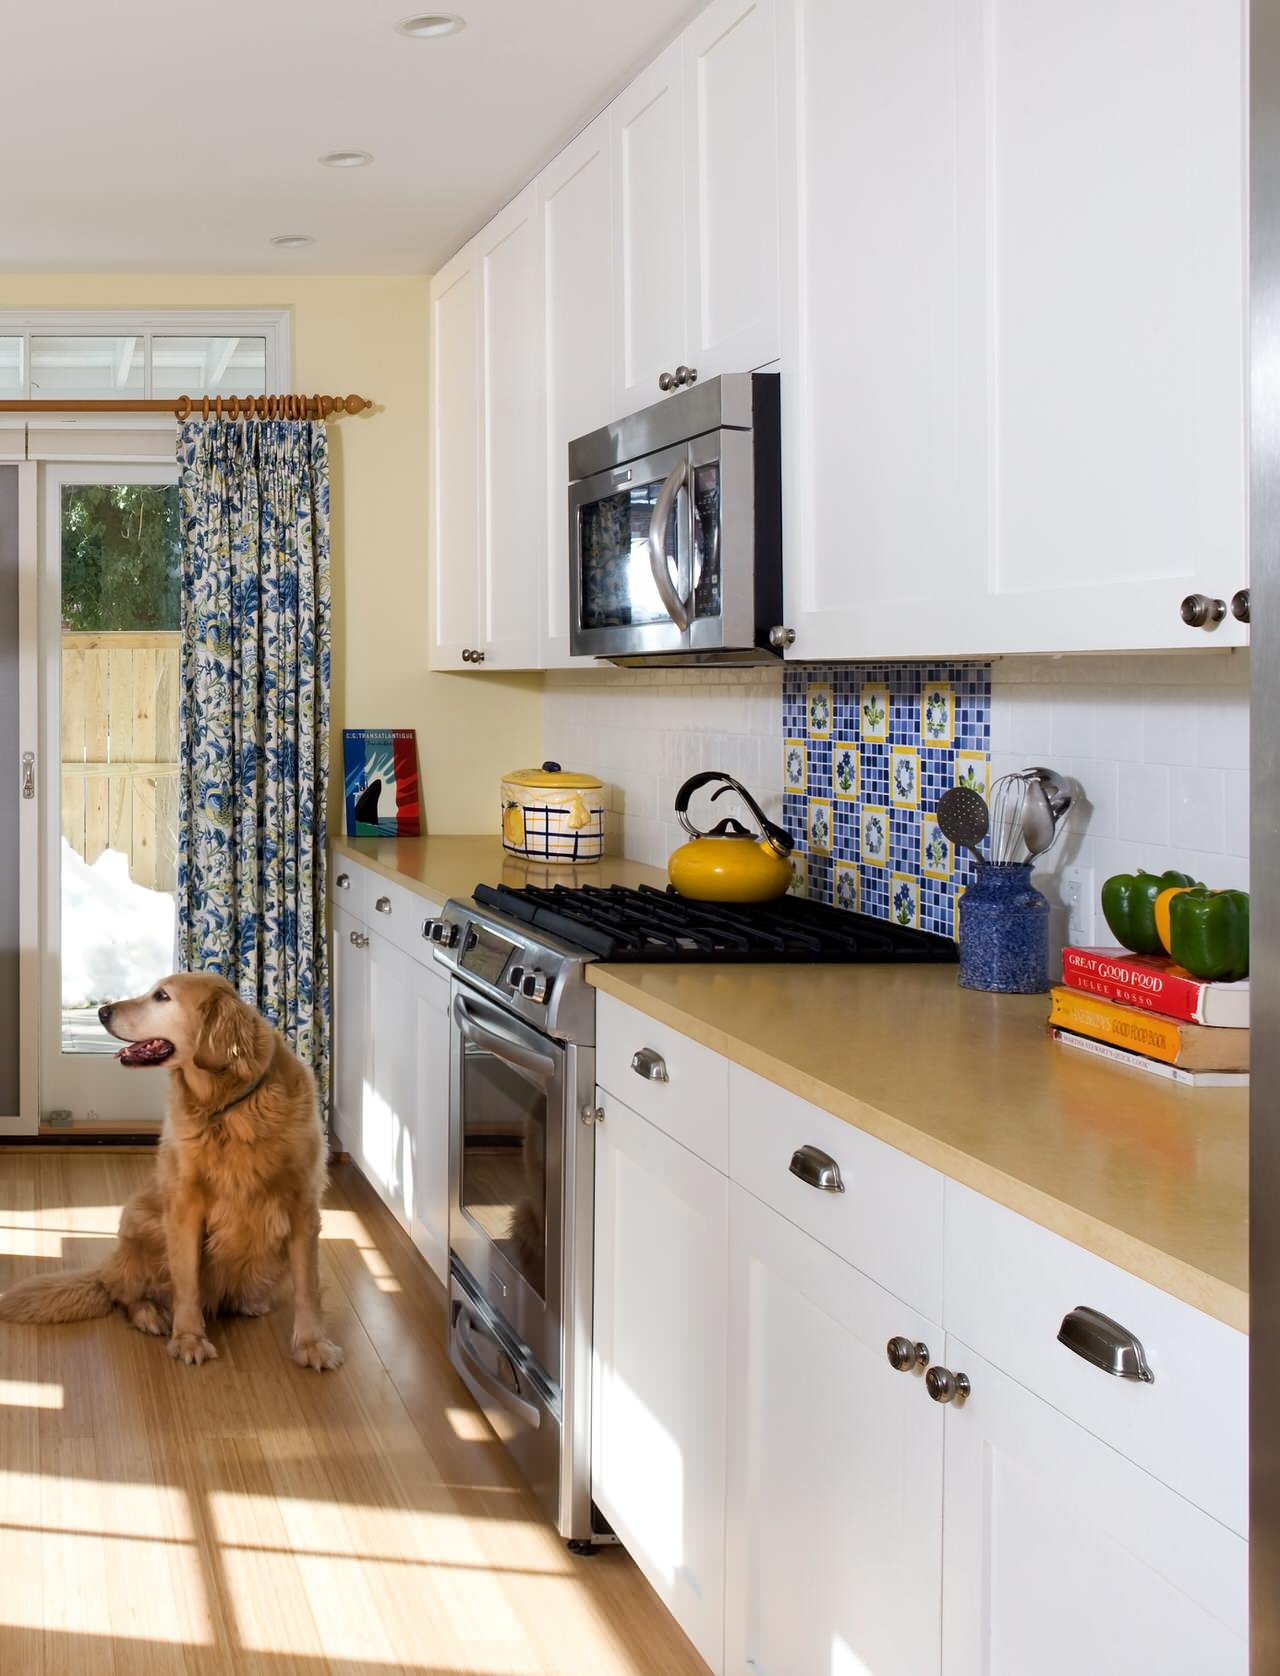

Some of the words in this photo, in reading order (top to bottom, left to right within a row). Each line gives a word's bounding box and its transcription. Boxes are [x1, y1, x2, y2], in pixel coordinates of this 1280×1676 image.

[1069, 954, 1097, 971] GREAT
[1098, 963, 1129, 983] GOOD
[1131, 971, 1163, 992] FOOD
[1078, 977, 1110, 994] JULEE
[1116, 988, 1153, 1006] ROSSO
